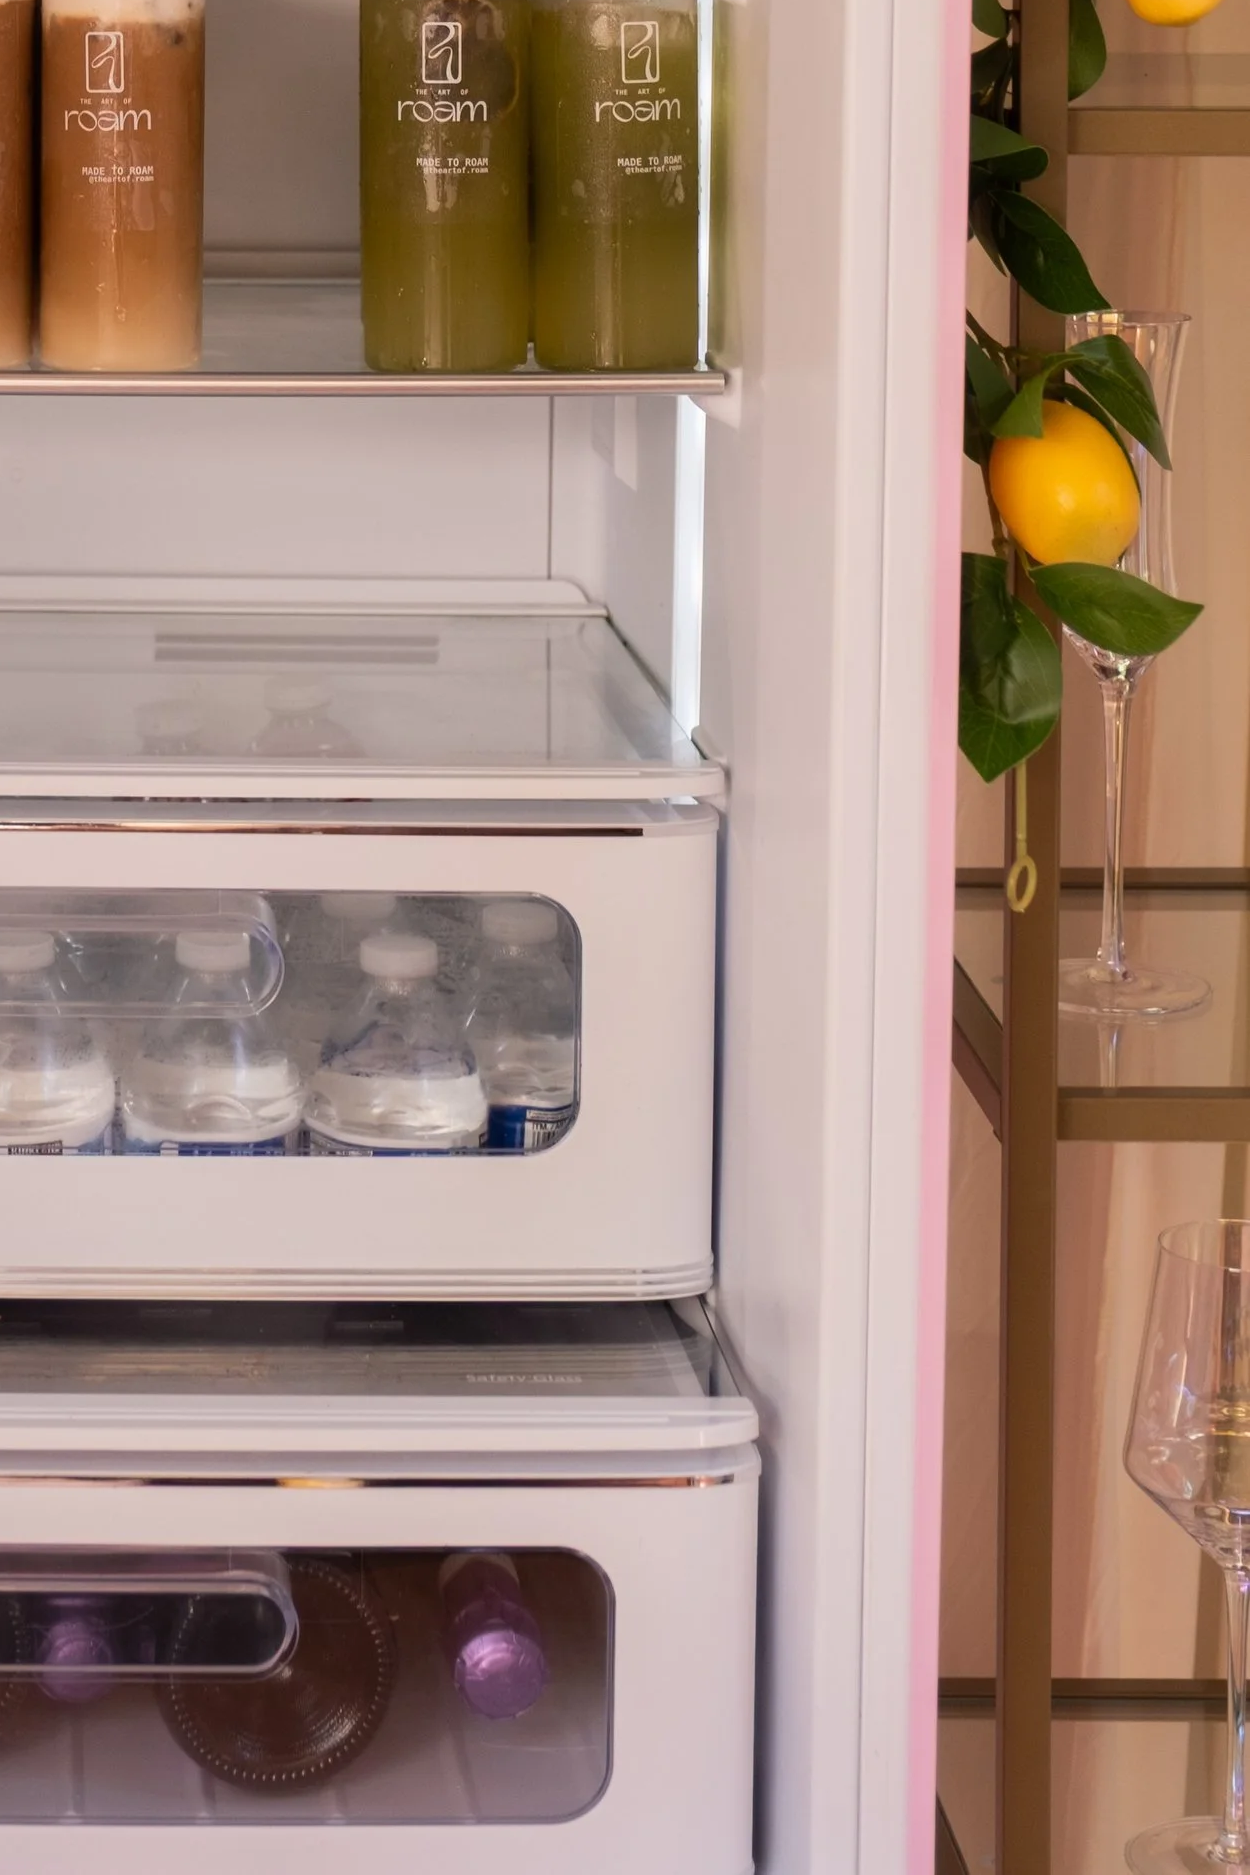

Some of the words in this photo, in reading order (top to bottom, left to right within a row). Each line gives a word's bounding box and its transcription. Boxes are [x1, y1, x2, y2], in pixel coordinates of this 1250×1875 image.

[415, 88, 427, 96] THE
[637, 87, 650, 95] ART
[397, 100, 488, 123] roam
[595, 98, 681, 123] roam
[64, 109, 152, 132] roam
[416, 158, 441, 167] MADE
[447, 158, 460, 167] TO
[465, 158, 489, 167] ROAM
[617, 157, 642, 167] MADE
[648, 156, 659, 166] TO
[663, 155, 682, 165] ROAM
[81, 166, 105, 175] MADE
[110, 166, 124, 175] TO
[129, 166, 154, 175] ROAM
[423, 166, 489, 174] @theartof.roam
[625, 165, 682, 175] @theartof.roam
[88, 175, 154, 184] @theartof.roam
[465, 1373, 526, 1384] Safety
[533, 1374, 583, 1383] Glass
